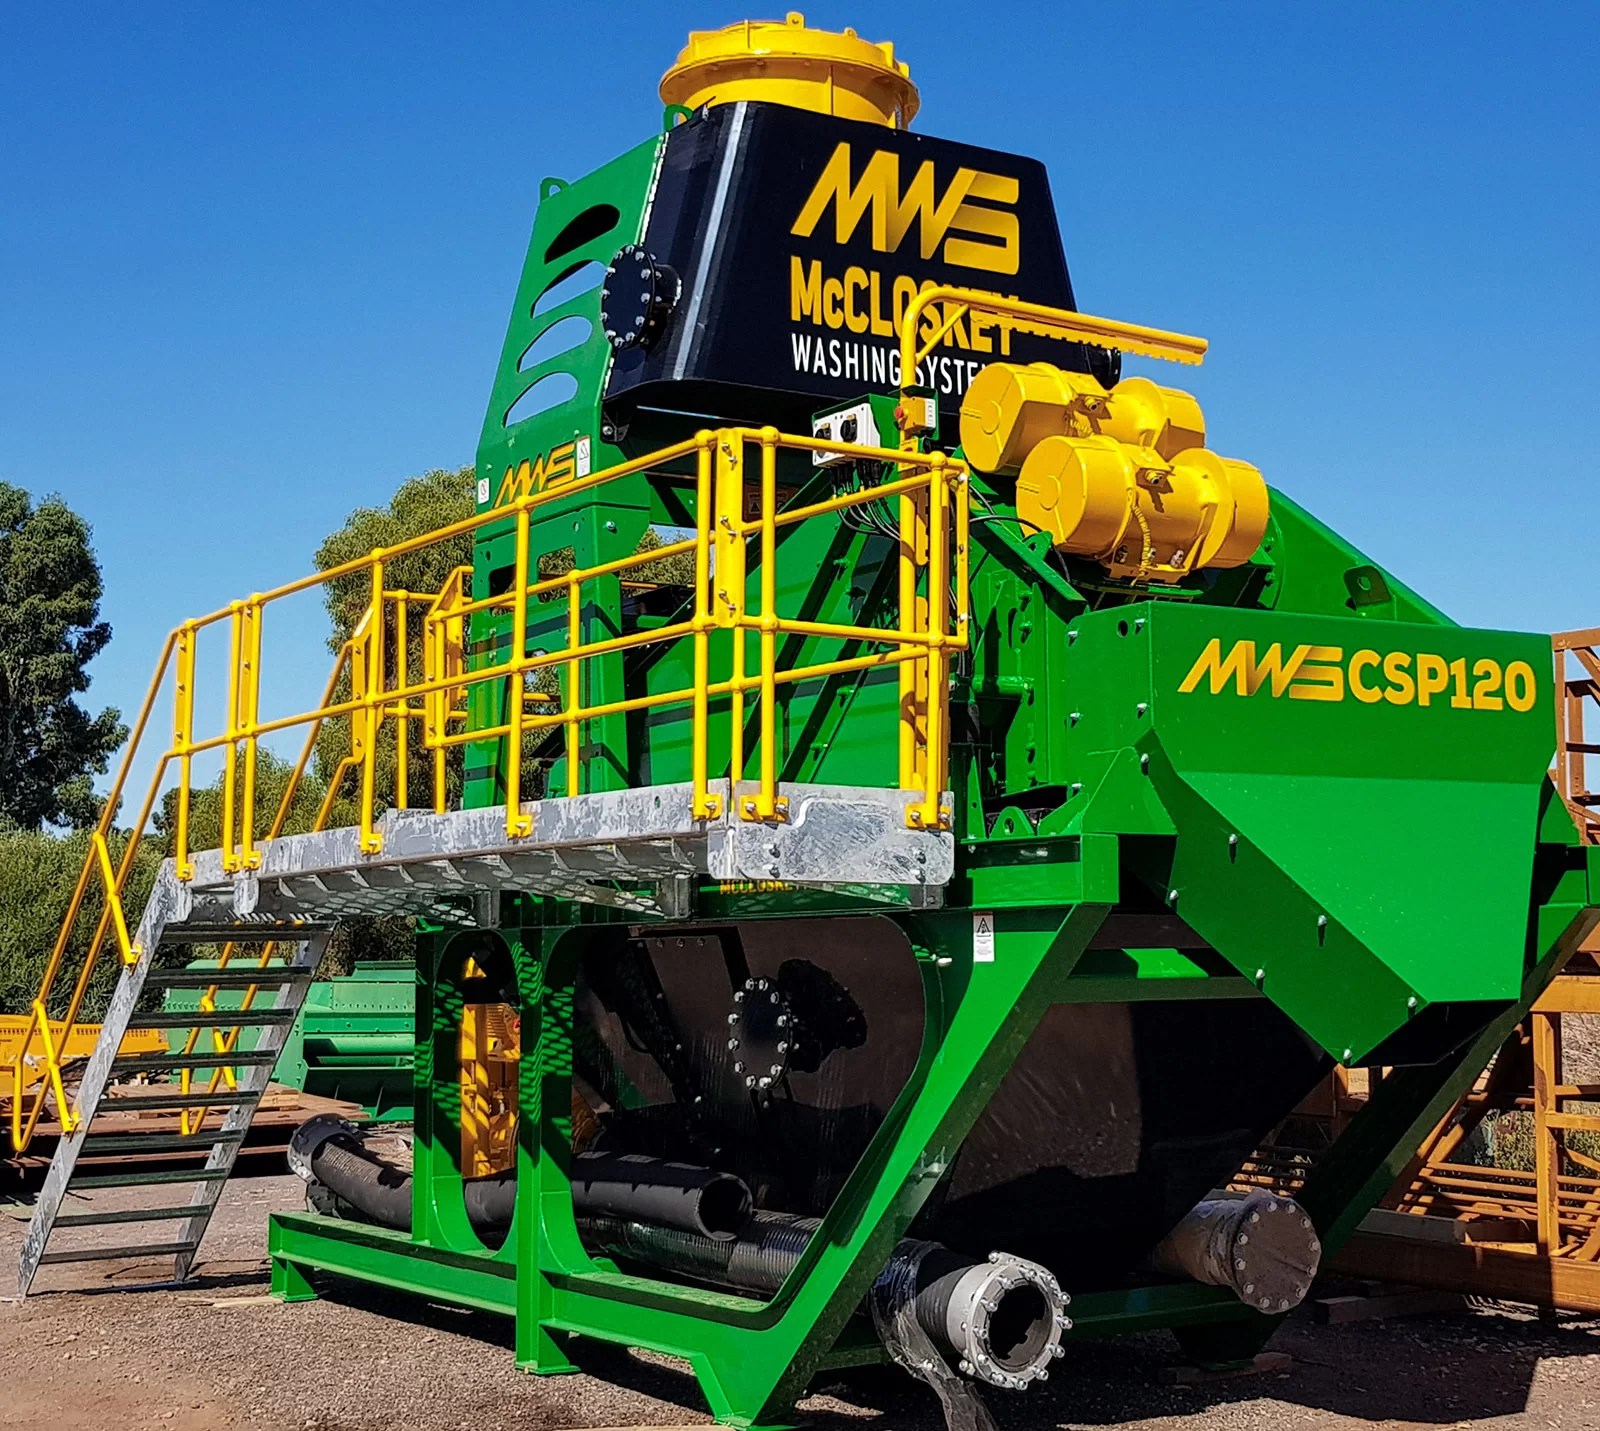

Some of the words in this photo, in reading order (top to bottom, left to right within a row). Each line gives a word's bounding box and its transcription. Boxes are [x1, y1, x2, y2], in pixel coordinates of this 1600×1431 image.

[790, 141, 1020, 275] MWS
[791, 333, 901, 387] WASHING
[1177, 638, 1344, 702] MWS
[1348, 649, 1537, 712] CSP120
